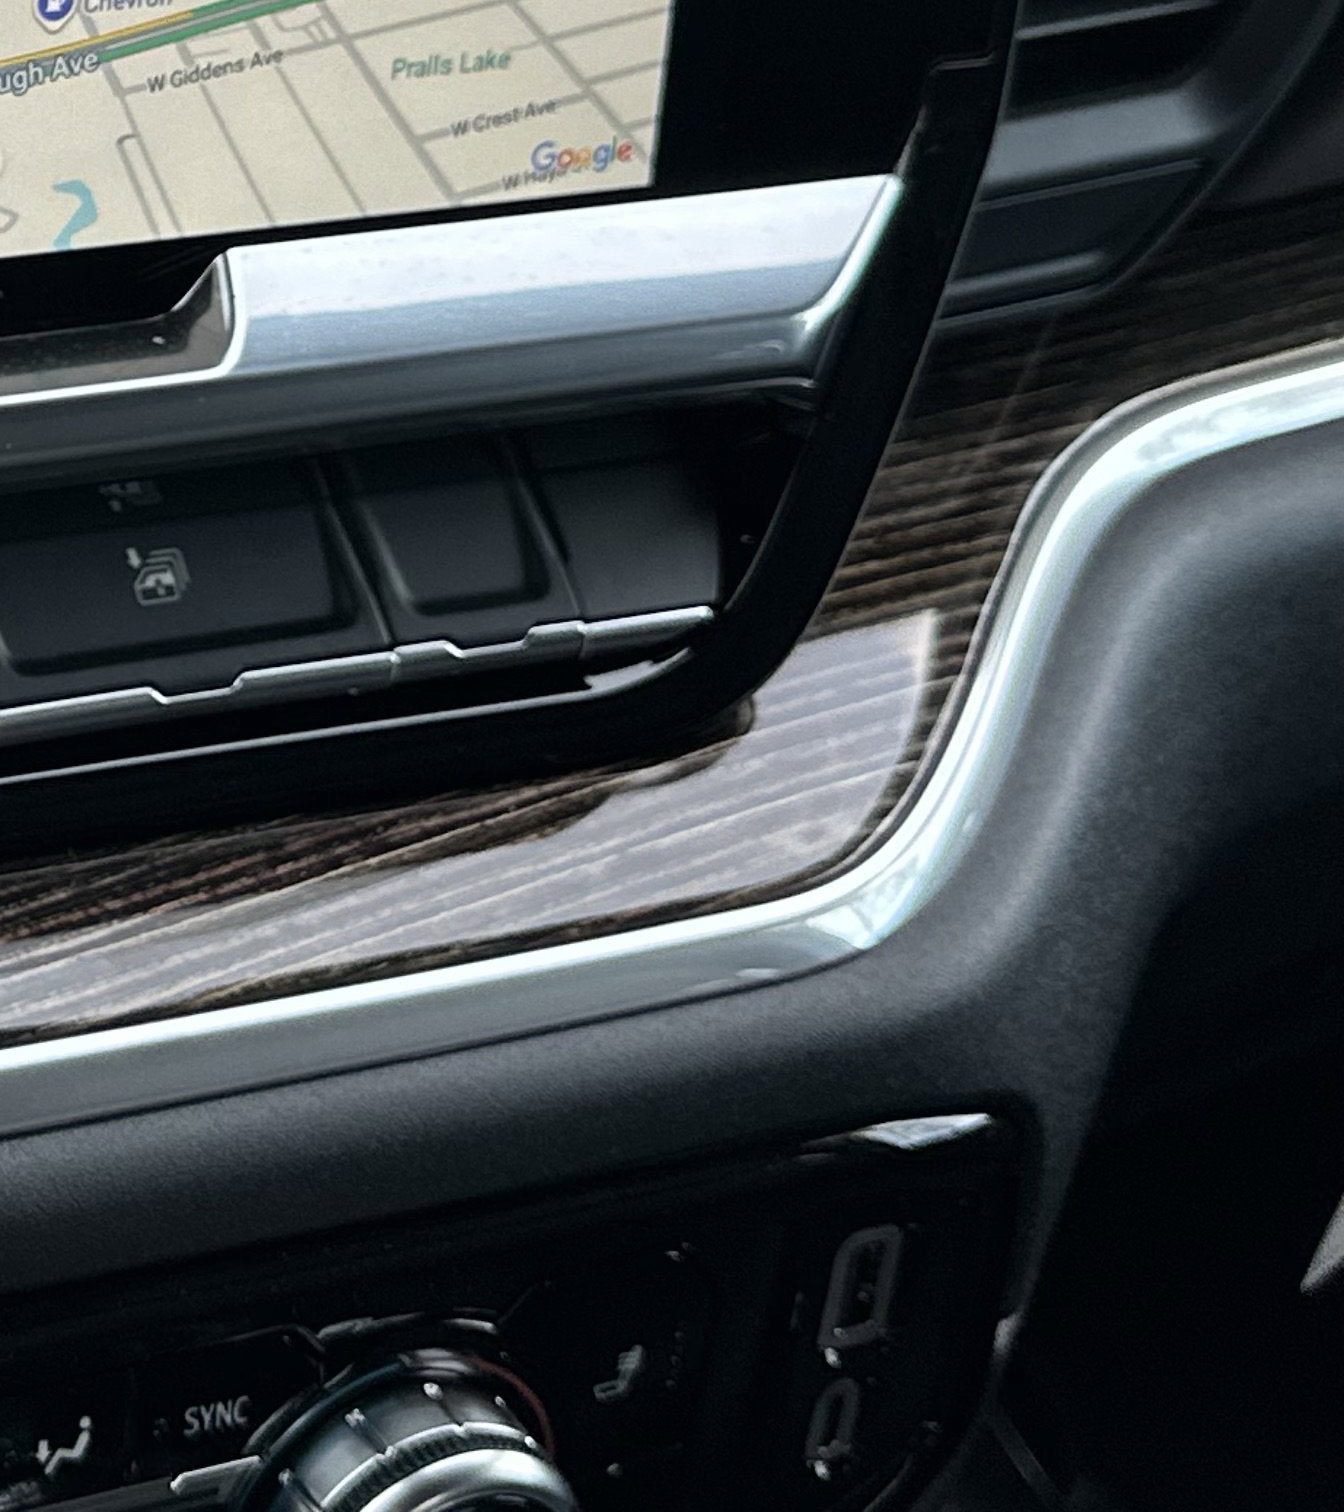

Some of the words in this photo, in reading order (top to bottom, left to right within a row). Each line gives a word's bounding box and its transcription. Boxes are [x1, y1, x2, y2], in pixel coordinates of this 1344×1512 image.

[52, 51, 100, 81] Ave
[147, 76, 166, 93] W
[171, 60, 245, 88] Giddens
[250, 49, 283, 69] Ave
[391, 56, 452, 79] Pralls
[460, 52, 510, 70] Lake
[450, 120, 468, 137] W
[473, 108, 521, 132] Crest
[525, 100, 556, 118] Ave
[531, 136, 633, 173] Google
[184, 1396, 251, 1436] SYNC
